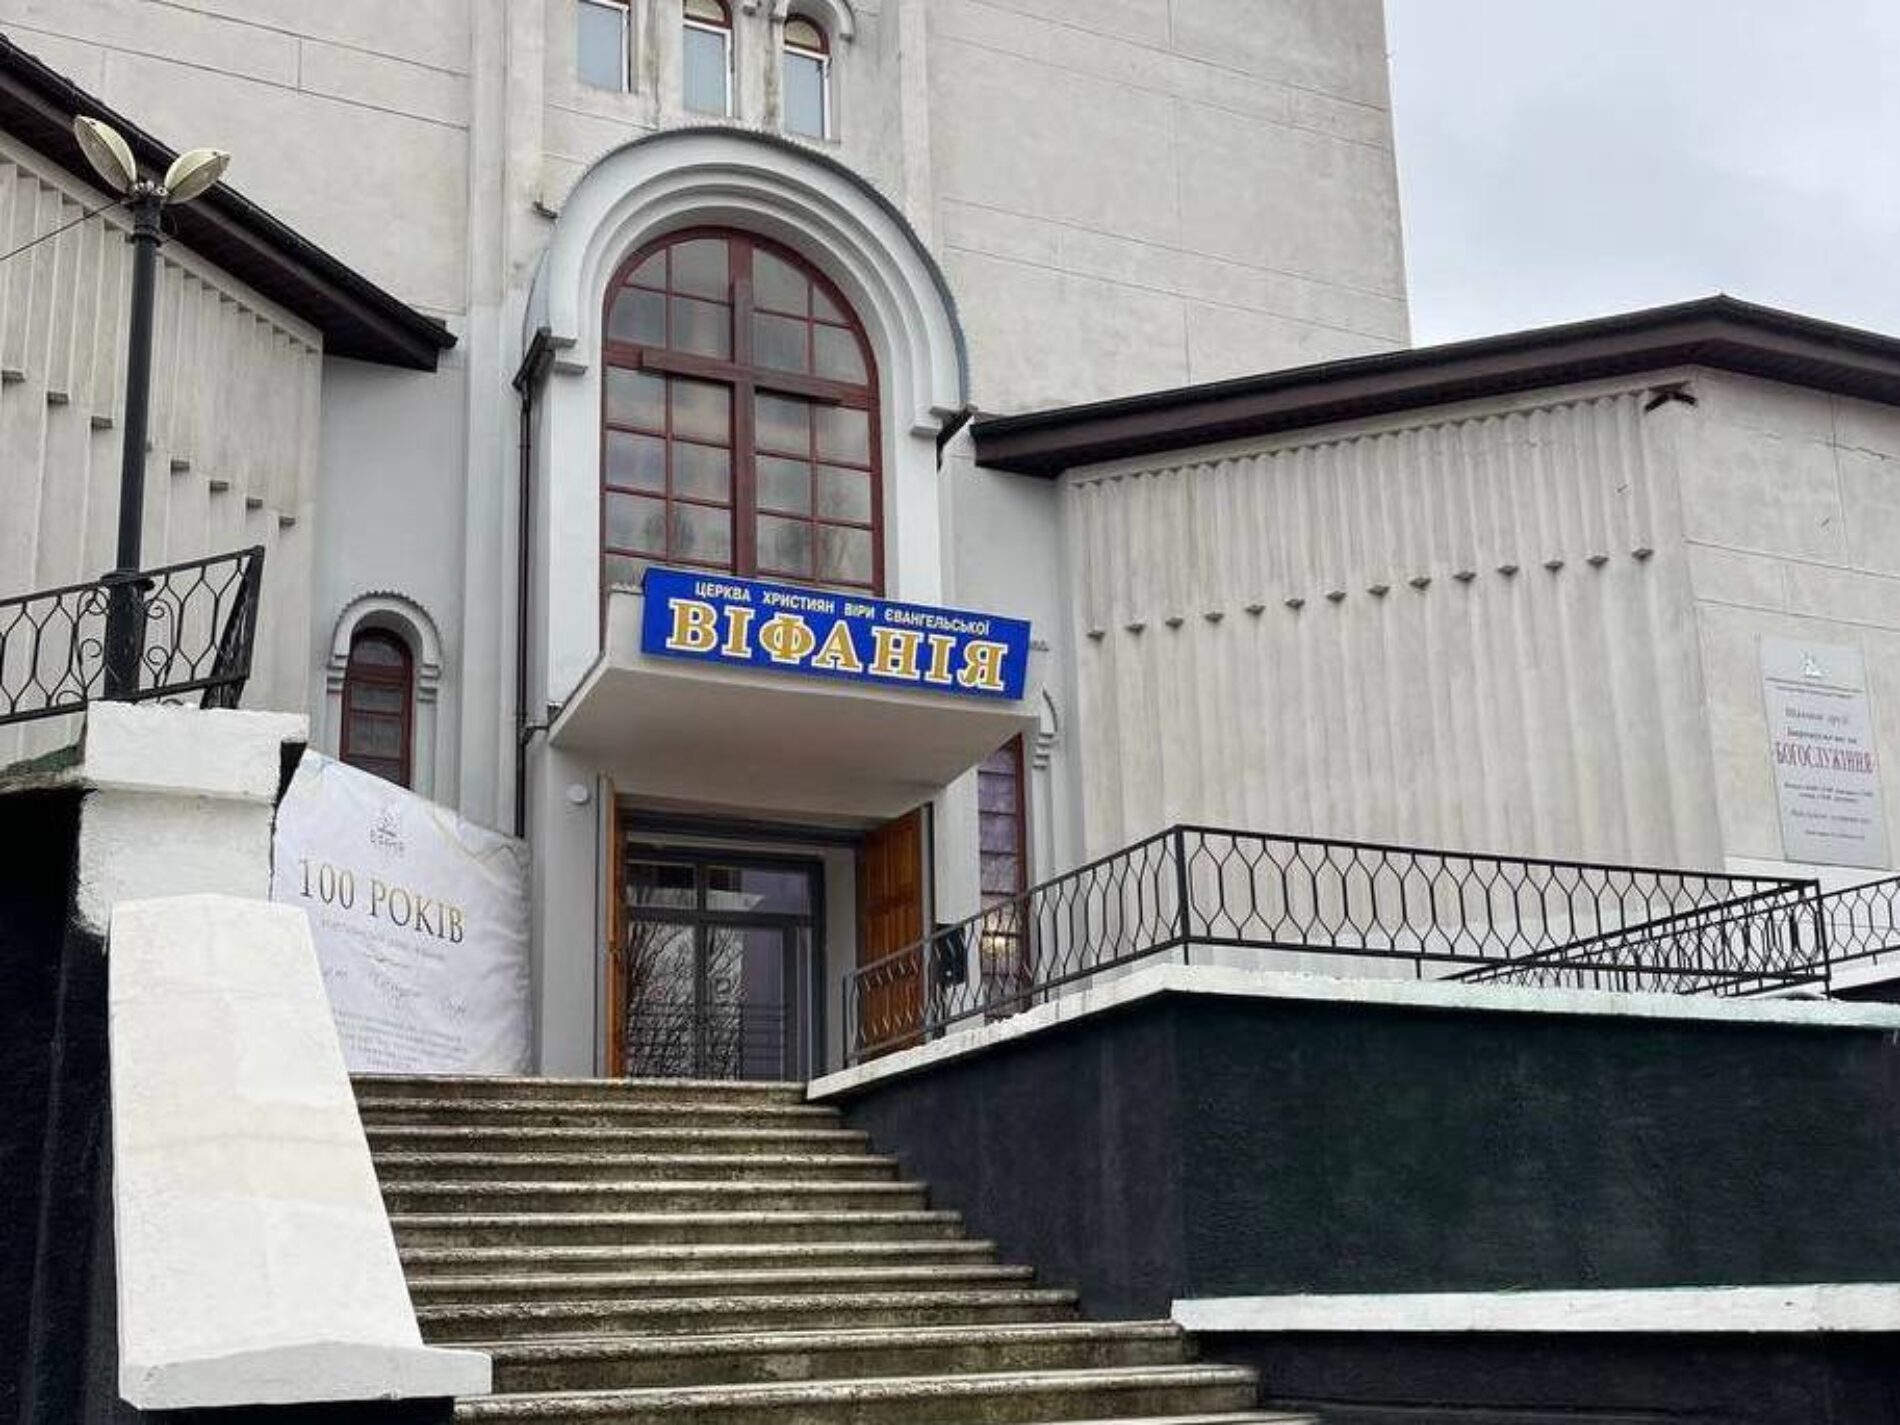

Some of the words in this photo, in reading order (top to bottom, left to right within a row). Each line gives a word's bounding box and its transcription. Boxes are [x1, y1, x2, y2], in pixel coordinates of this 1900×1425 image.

[665, 597, 1008, 691] ВІФАНІЯ
[695, 581, 750, 602] ЦЕРКВА
[763, 590, 835, 614] ХРИСТИЯН
[844, 602, 875, 620] ВІРИ
[884, 608, 990, 636] ЄВАНГЕЛЬСЬКОЇ
[299, 858, 355, 910] 100
[368, 879, 464, 943] РОКІВ
